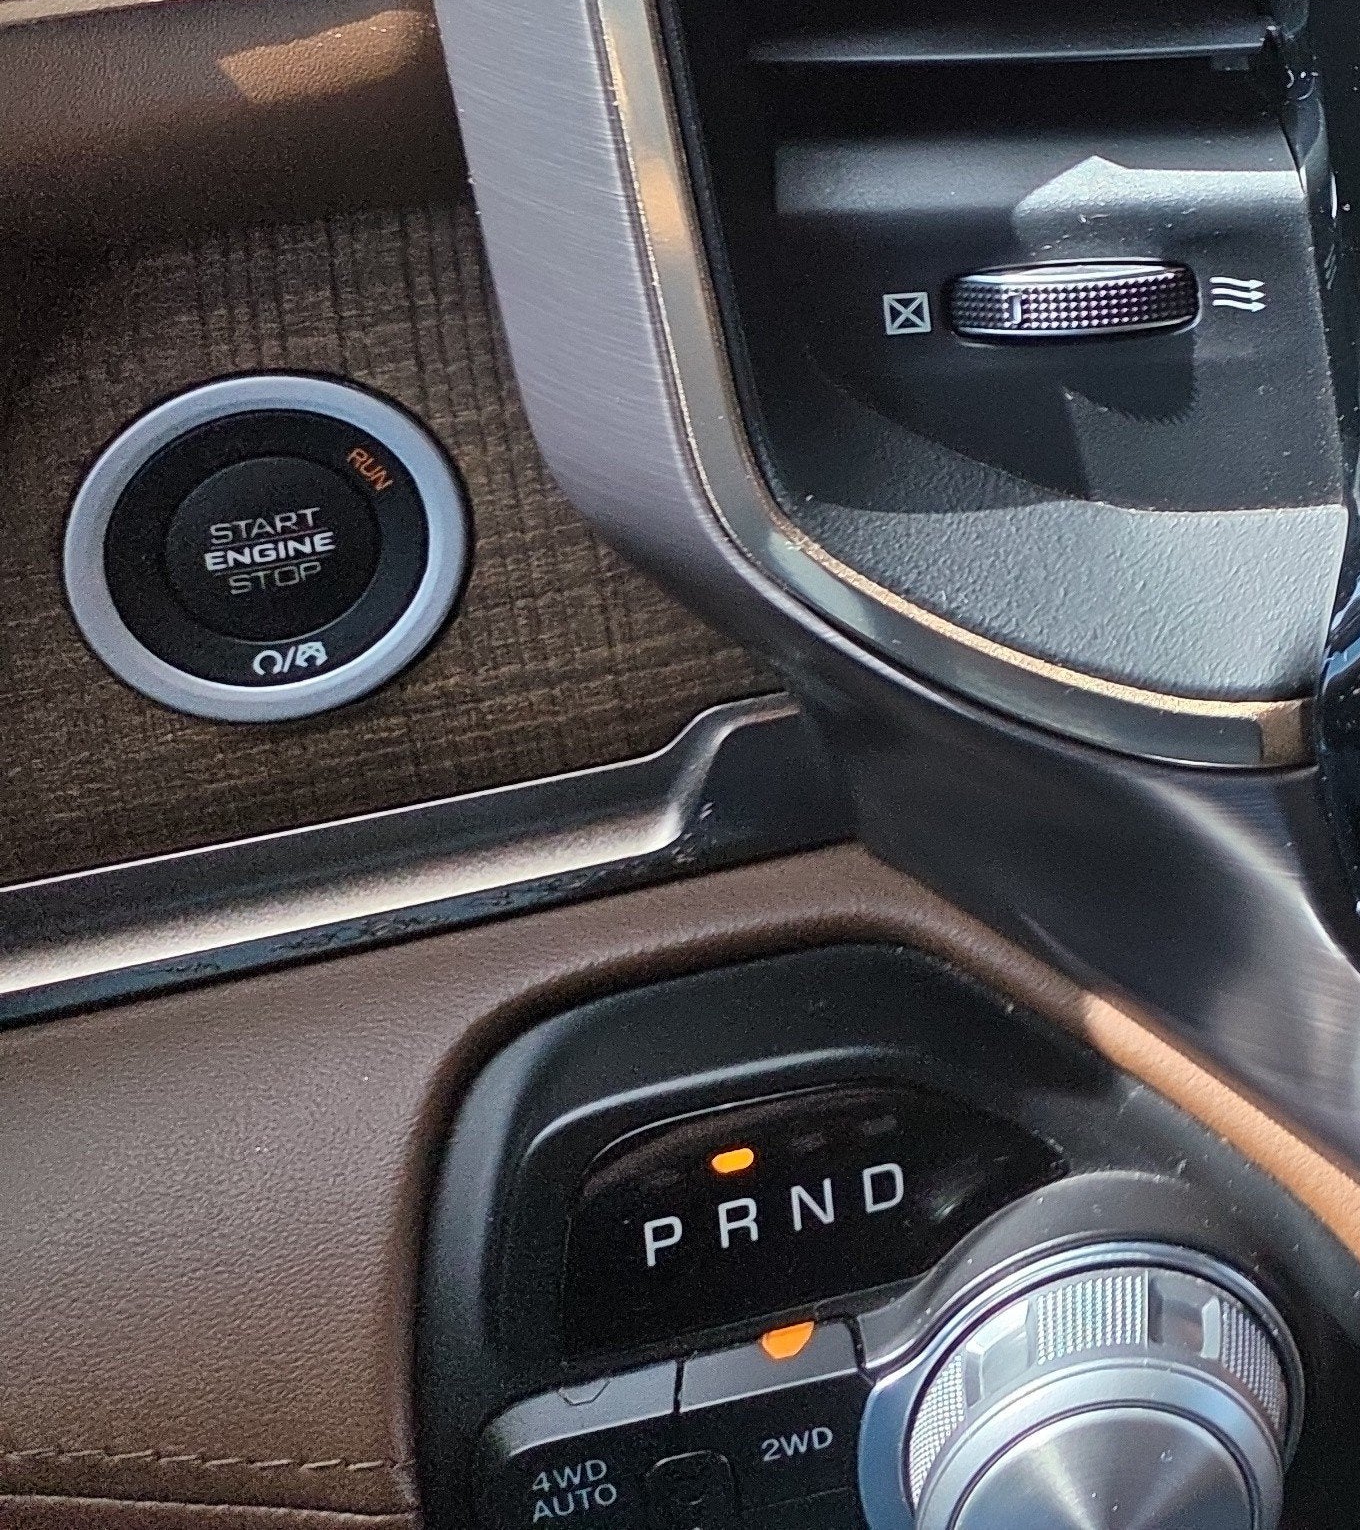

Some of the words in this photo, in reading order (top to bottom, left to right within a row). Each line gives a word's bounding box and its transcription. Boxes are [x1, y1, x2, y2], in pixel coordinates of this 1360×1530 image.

[347, 447, 393, 492] RUN
[210, 507, 321, 545] START
[205, 532, 336, 571] ENGINE
[229, 561, 322, 595] STOP
[645, 1215, 683, 1267] P
[717, 1198, 759, 1248] R
[790, 1178, 835, 1230] N
[863, 1162, 904, 1214] D
[761, 1426, 834, 1461] 2WD
[532, 1459, 608, 1492] 4WD
[532, 1483, 617, 1521] AUTO
